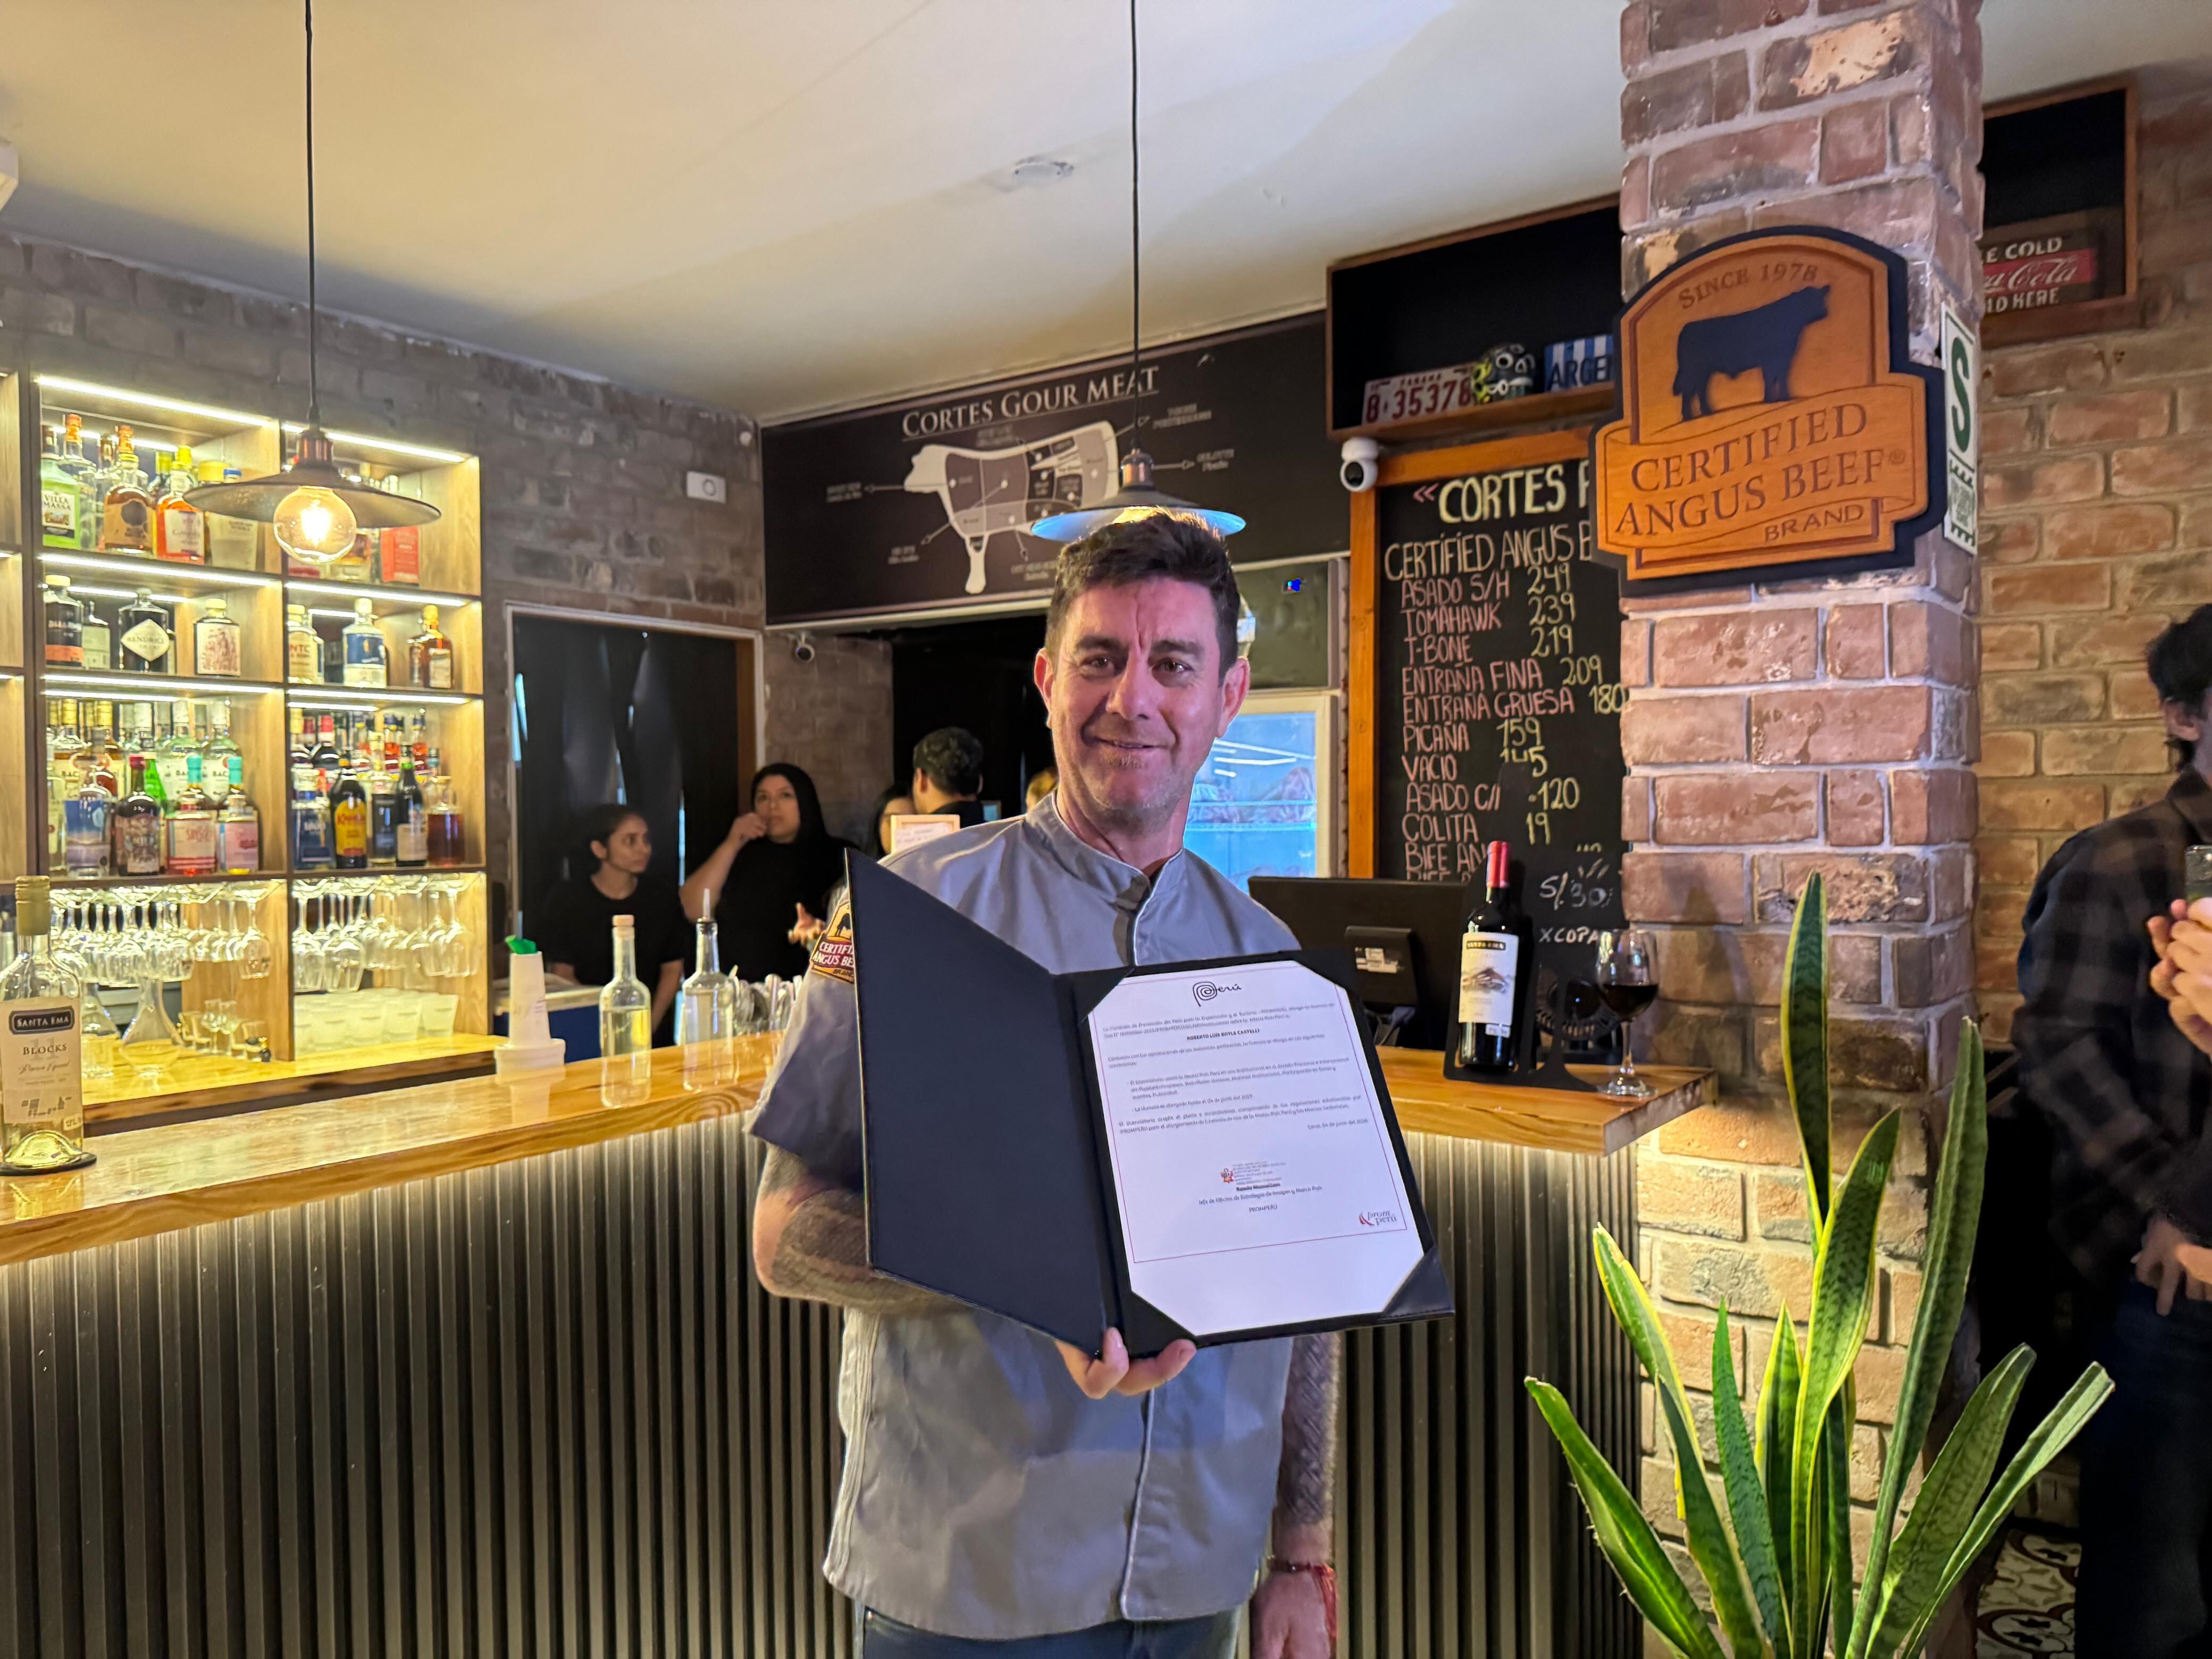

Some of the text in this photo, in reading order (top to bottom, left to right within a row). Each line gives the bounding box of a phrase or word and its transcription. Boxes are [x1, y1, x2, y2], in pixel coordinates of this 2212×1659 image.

[2005, 237, 2063, 259] COLD
[1678, 263, 1818, 310] SINCE 1978
[2013, 287, 2059, 308] HERE
[902, 399, 993, 437] CORTES
[1001, 383, 1079, 417] GOUR
[1087, 366, 1159, 403] MEAT
[1951, 337, 1971, 454] S
[1631, 402, 1868, 492] CERTIFIED
[1438, 464, 1566, 523] CORTES
[1615, 474, 1766, 537] ANGUS
[1764, 504, 1865, 542] BRAND
[1501, 524, 1574, 567] ANGUS
[1401, 562, 1572, 609] ASADO S/H 249
[1401, 592, 1576, 637] TOMAHAWK 239
[1404, 624, 1574, 665] T-BONE 219
[1402, 655, 1603, 696] ENTRAÑA FINA 209
[1494, 686, 1574, 718] GRUESA
[1589, 683, 1630, 714] 180
[1402, 716, 1541, 752] PICAÑA 159
[1499, 745, 1548, 778] 145
[1406, 782, 1470, 812] ASADO
[1405, 842, 1447, 872] BIFE
[812, 951, 840, 965] ANGUS
[17, 1016, 69, 1027] SANTA EMA
[23, 1043, 67, 1055] BLOCKS
